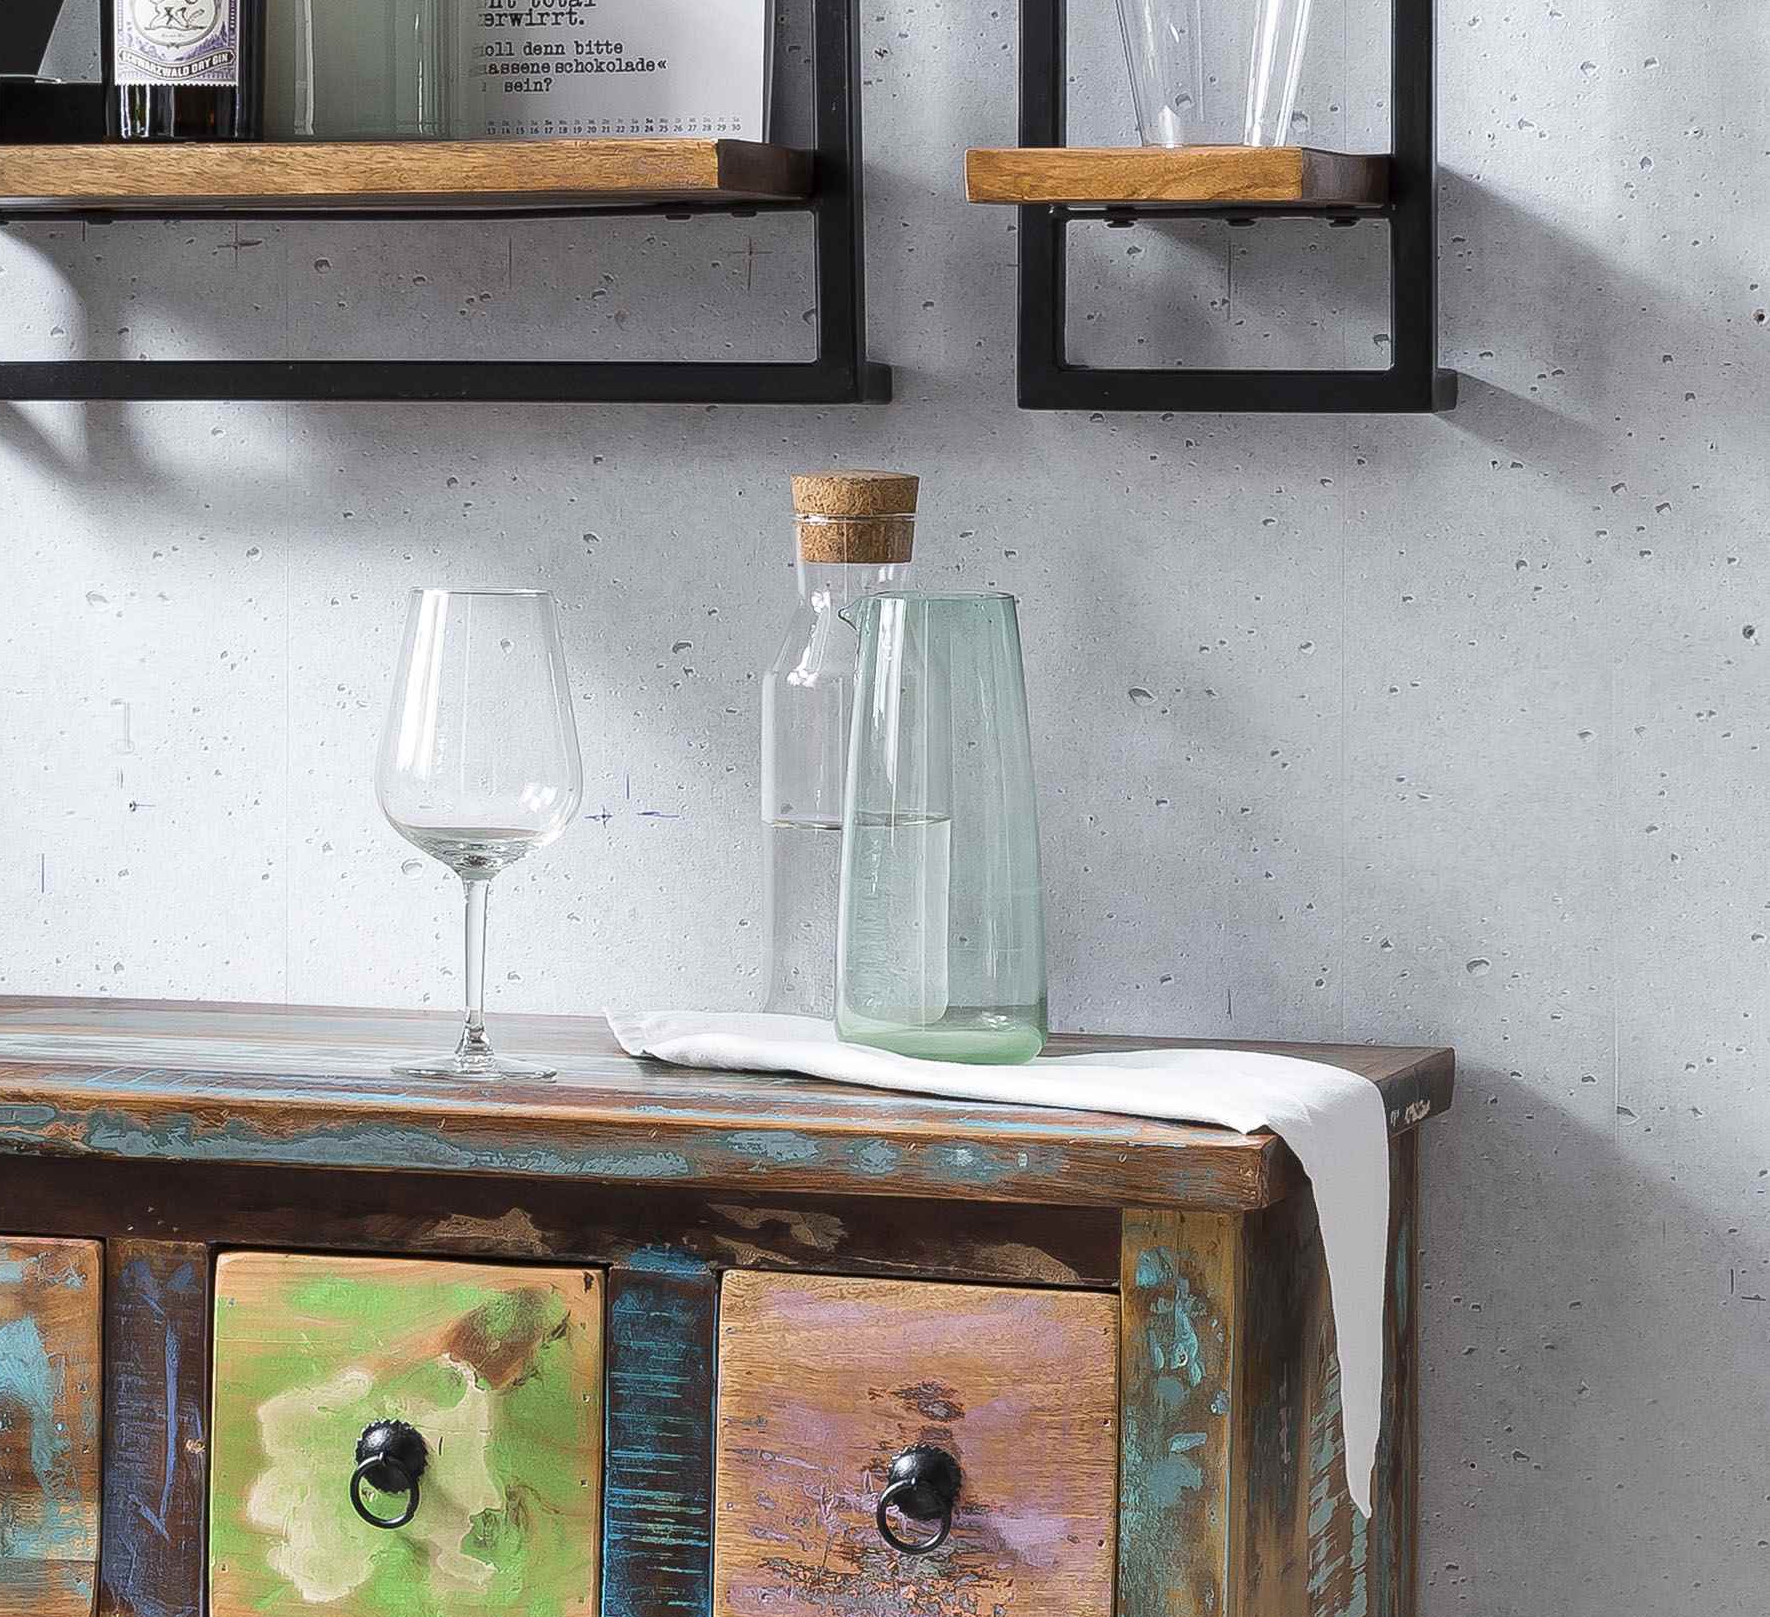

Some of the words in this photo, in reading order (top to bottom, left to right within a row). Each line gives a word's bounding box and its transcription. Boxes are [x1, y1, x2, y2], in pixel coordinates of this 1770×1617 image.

[479, 8, 585, 27] erwirrt.
[479, 41, 515, 57] oll
[523, 42, 566, 56] denn
[574, 40, 624, 55] bitte
[191, 58, 211, 73] DRY
[212, 53, 229, 63] GIN
[555, 57, 668, 74] schokolade«
[504, 77, 553, 93] sein?
